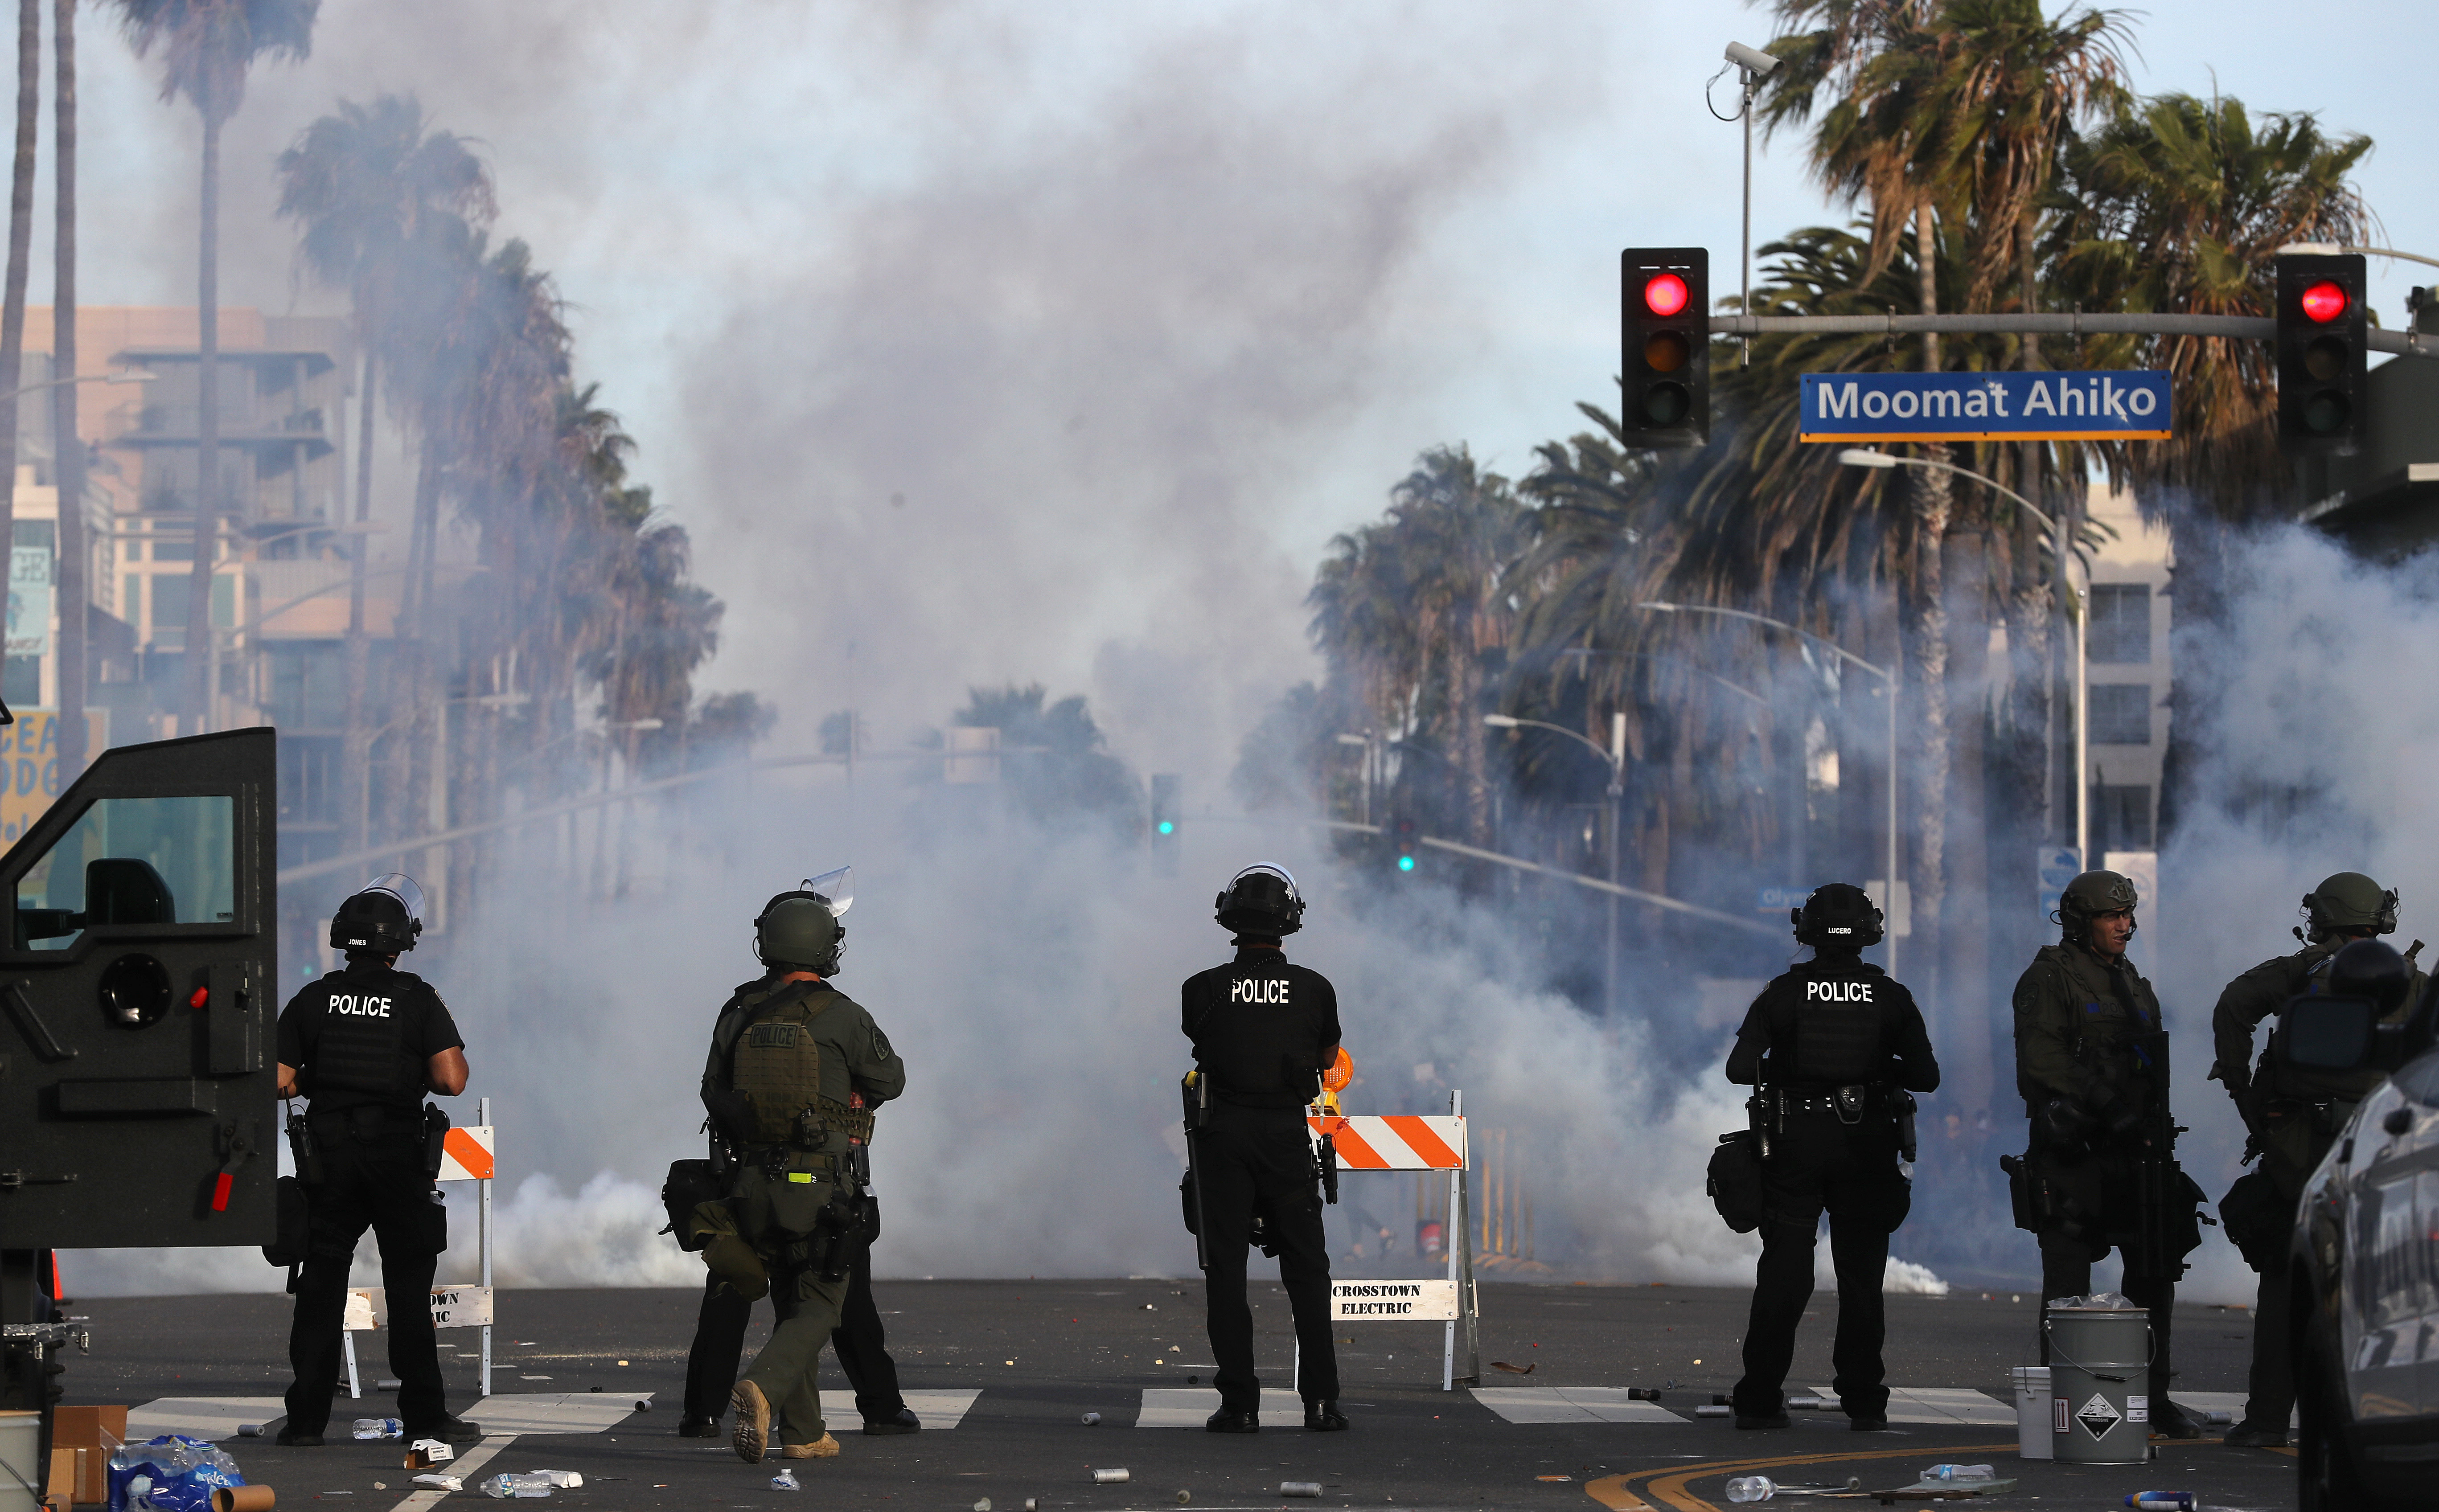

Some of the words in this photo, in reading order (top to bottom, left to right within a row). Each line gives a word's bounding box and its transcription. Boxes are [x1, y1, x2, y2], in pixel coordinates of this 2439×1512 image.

[1819, 381, 2008, 418] Moomat
[2023, 377, 2157, 417] Ahiko
[1232, 979, 1289, 1004] POLICE
[1807, 981, 1873, 1002] POLICE
[328, 995, 391, 1017] POLICE
[752, 1026, 794, 1045] POLICE
[1332, 1285, 1421, 1297] CROSSTOWN
[1341, 1302, 1412, 1314] ELECTRIC
